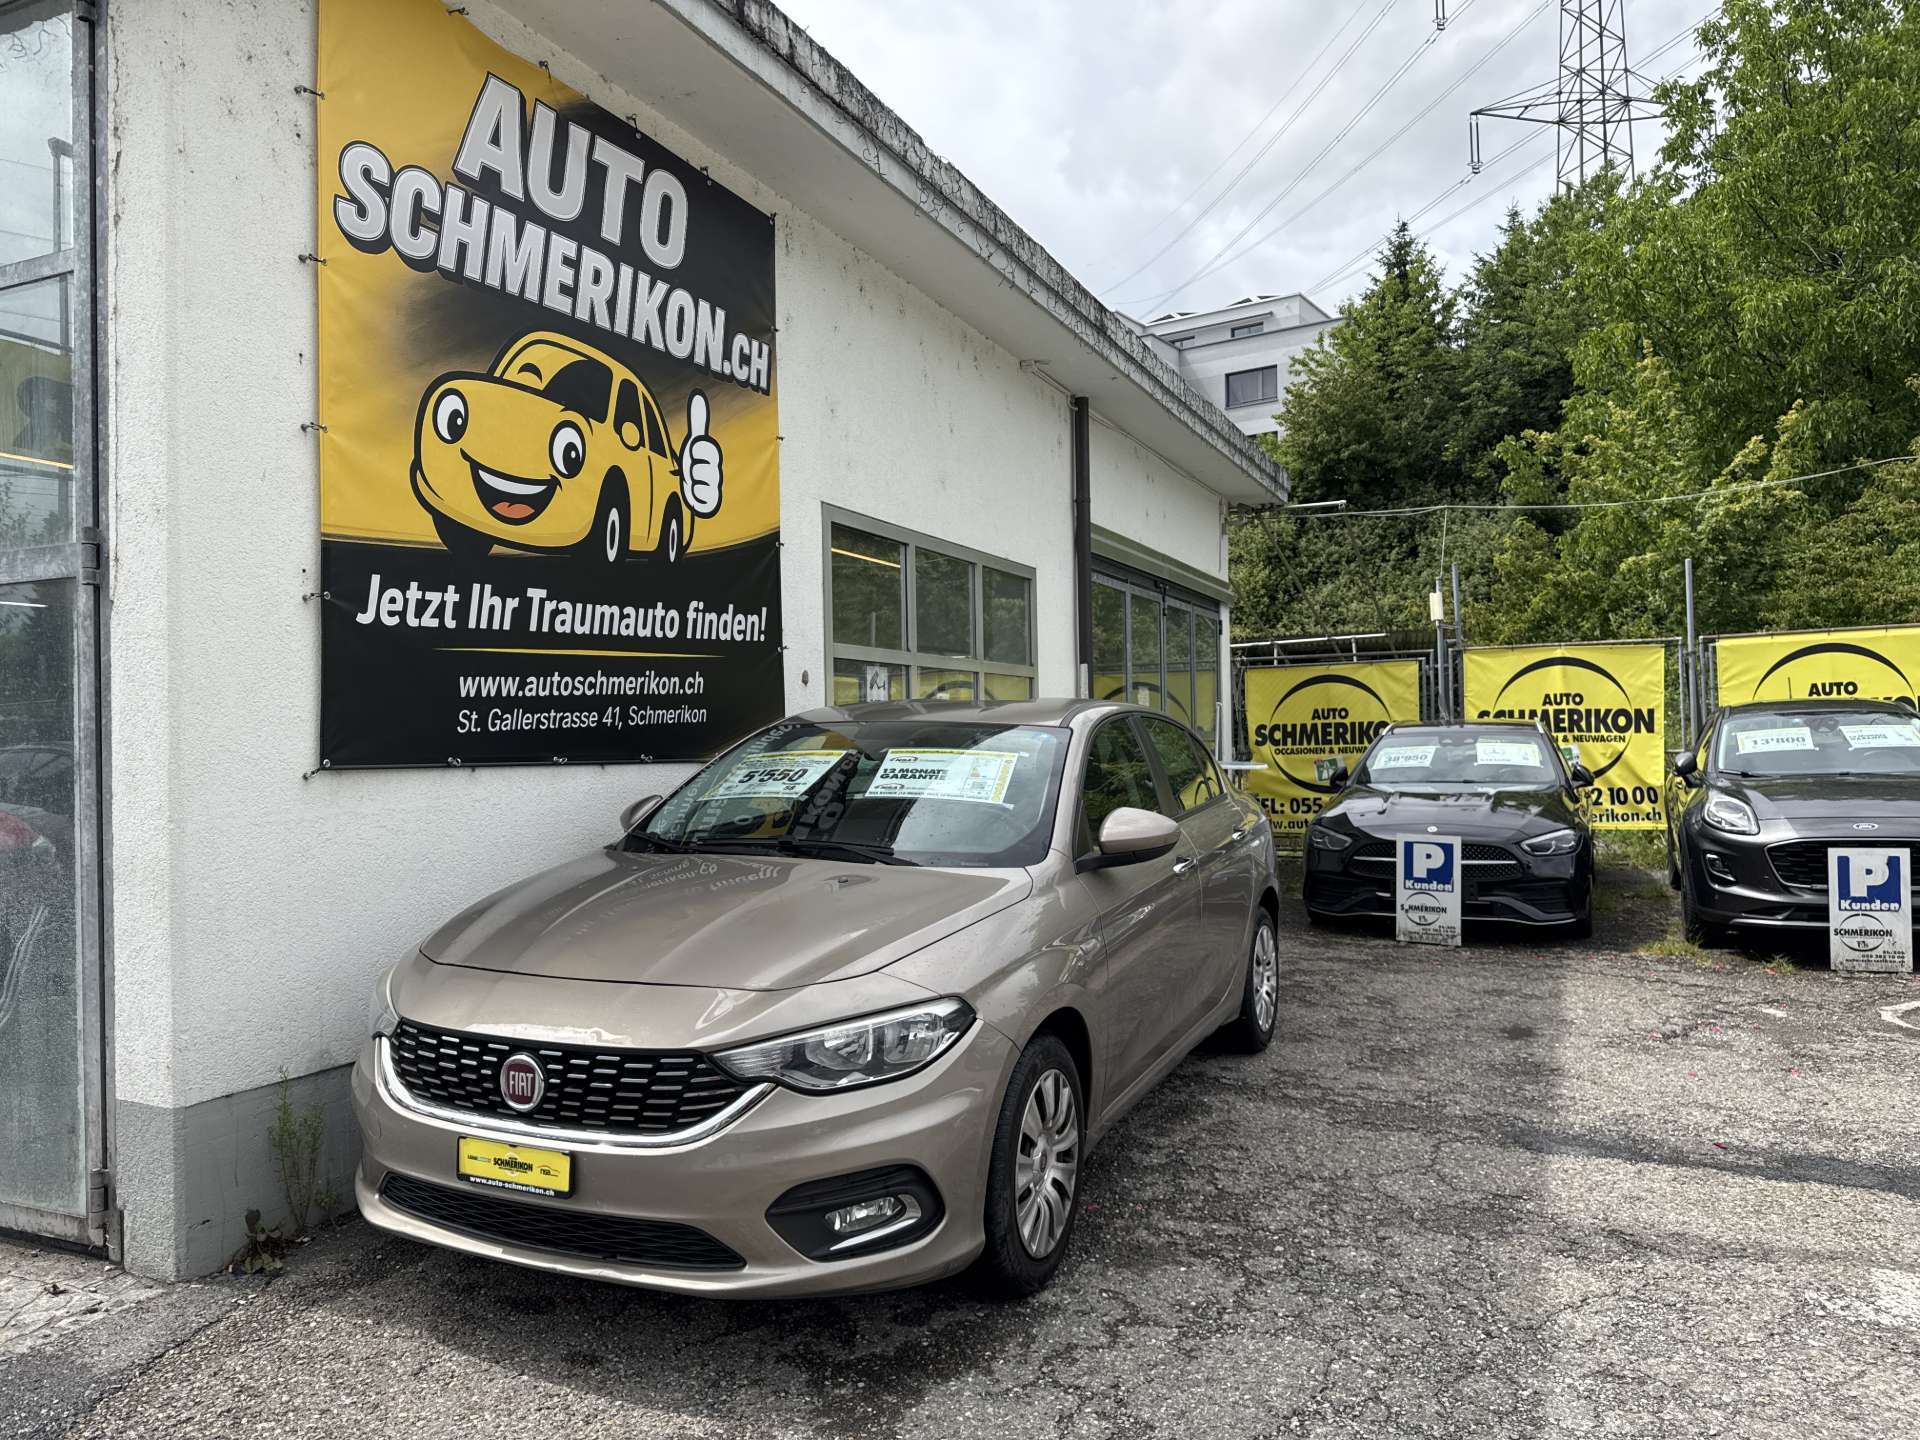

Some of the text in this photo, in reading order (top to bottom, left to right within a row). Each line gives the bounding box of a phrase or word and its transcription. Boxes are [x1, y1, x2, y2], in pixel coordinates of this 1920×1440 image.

[454, 73, 689, 270] AUTO
[335, 143, 770, 392] SCHMERIKON.CH
[356, 574, 767, 642] Jetzt Ihr Traumauto finden!
[459, 671, 704, 698] www.autoschmerikon.ch
[1808, 681, 1858, 697] AUTO
[1542, 693, 1584, 706] AUTO
[457, 705, 707, 733] St. Gallerstrasse 41, Schmerikon
[1312, 707, 1349, 720] AUTO
[1255, 720, 1391, 747] SCHMERIKO
[1572, 734, 1626, 743] NEUWAGEN
[1275, 746, 1326, 756] OCCASIONEN
[738, 768, 809, 784] 5'550
[1290, 797, 1323, 814] 055
[1413, 843, 1446, 878] P
[1848, 857, 1889, 897] P
[1405, 879, 1453, 892] Kunden
[1400, 903, 1447, 914] SHMERIKON
[1840, 899, 1900, 911] Kunden
[1833, 928, 1893, 937] SCHMERIKON
[509, 1071, 534, 1096] FIAT
[493, 1157, 533, 1172] SCHMERIKON
[469, 1176, 555, 1196] www.auto-schmerikon.ch
